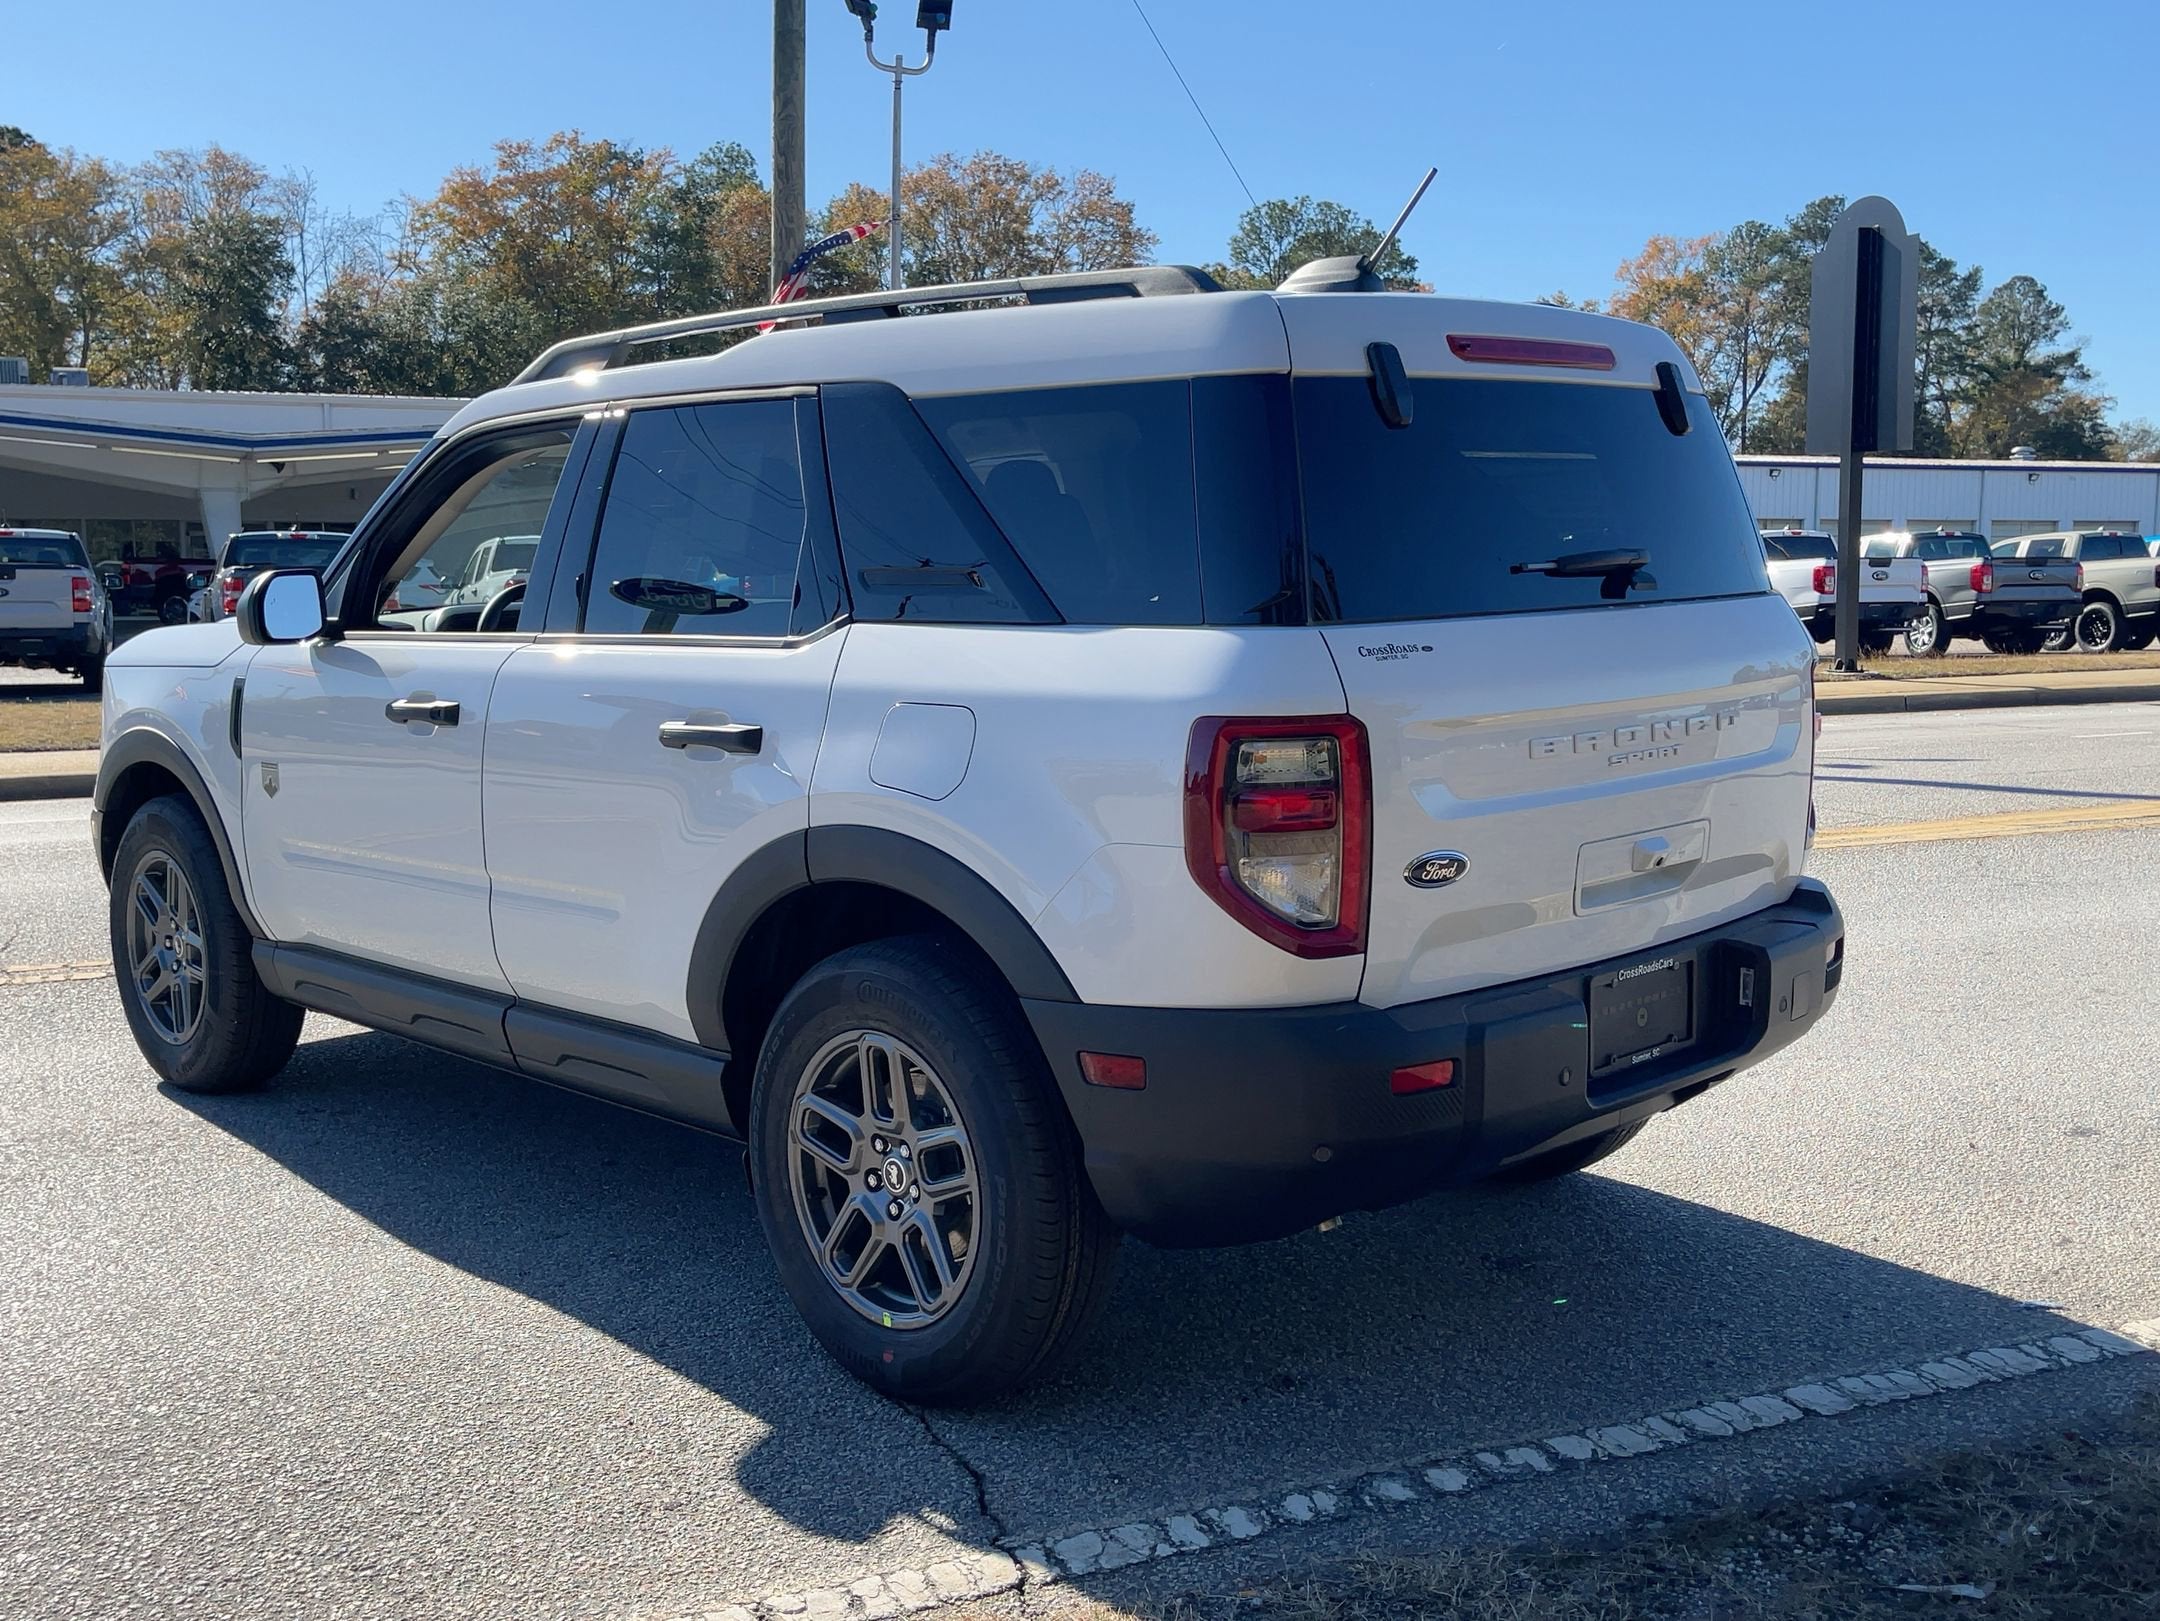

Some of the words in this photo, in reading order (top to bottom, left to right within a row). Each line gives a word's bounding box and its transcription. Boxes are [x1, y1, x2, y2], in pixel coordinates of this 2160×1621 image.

[1358, 645, 1419, 657] CROSSROADS
[1530, 710, 1741, 759] BRONCO
[1608, 744, 1682, 767] SPORT
[1422, 859, 1458, 880] Ford
[1618, 958, 1673, 981] CrossRoadsCars
[1631, 1053, 1651, 1064] Sumter,
[1652, 1048, 1660, 1057] SC
